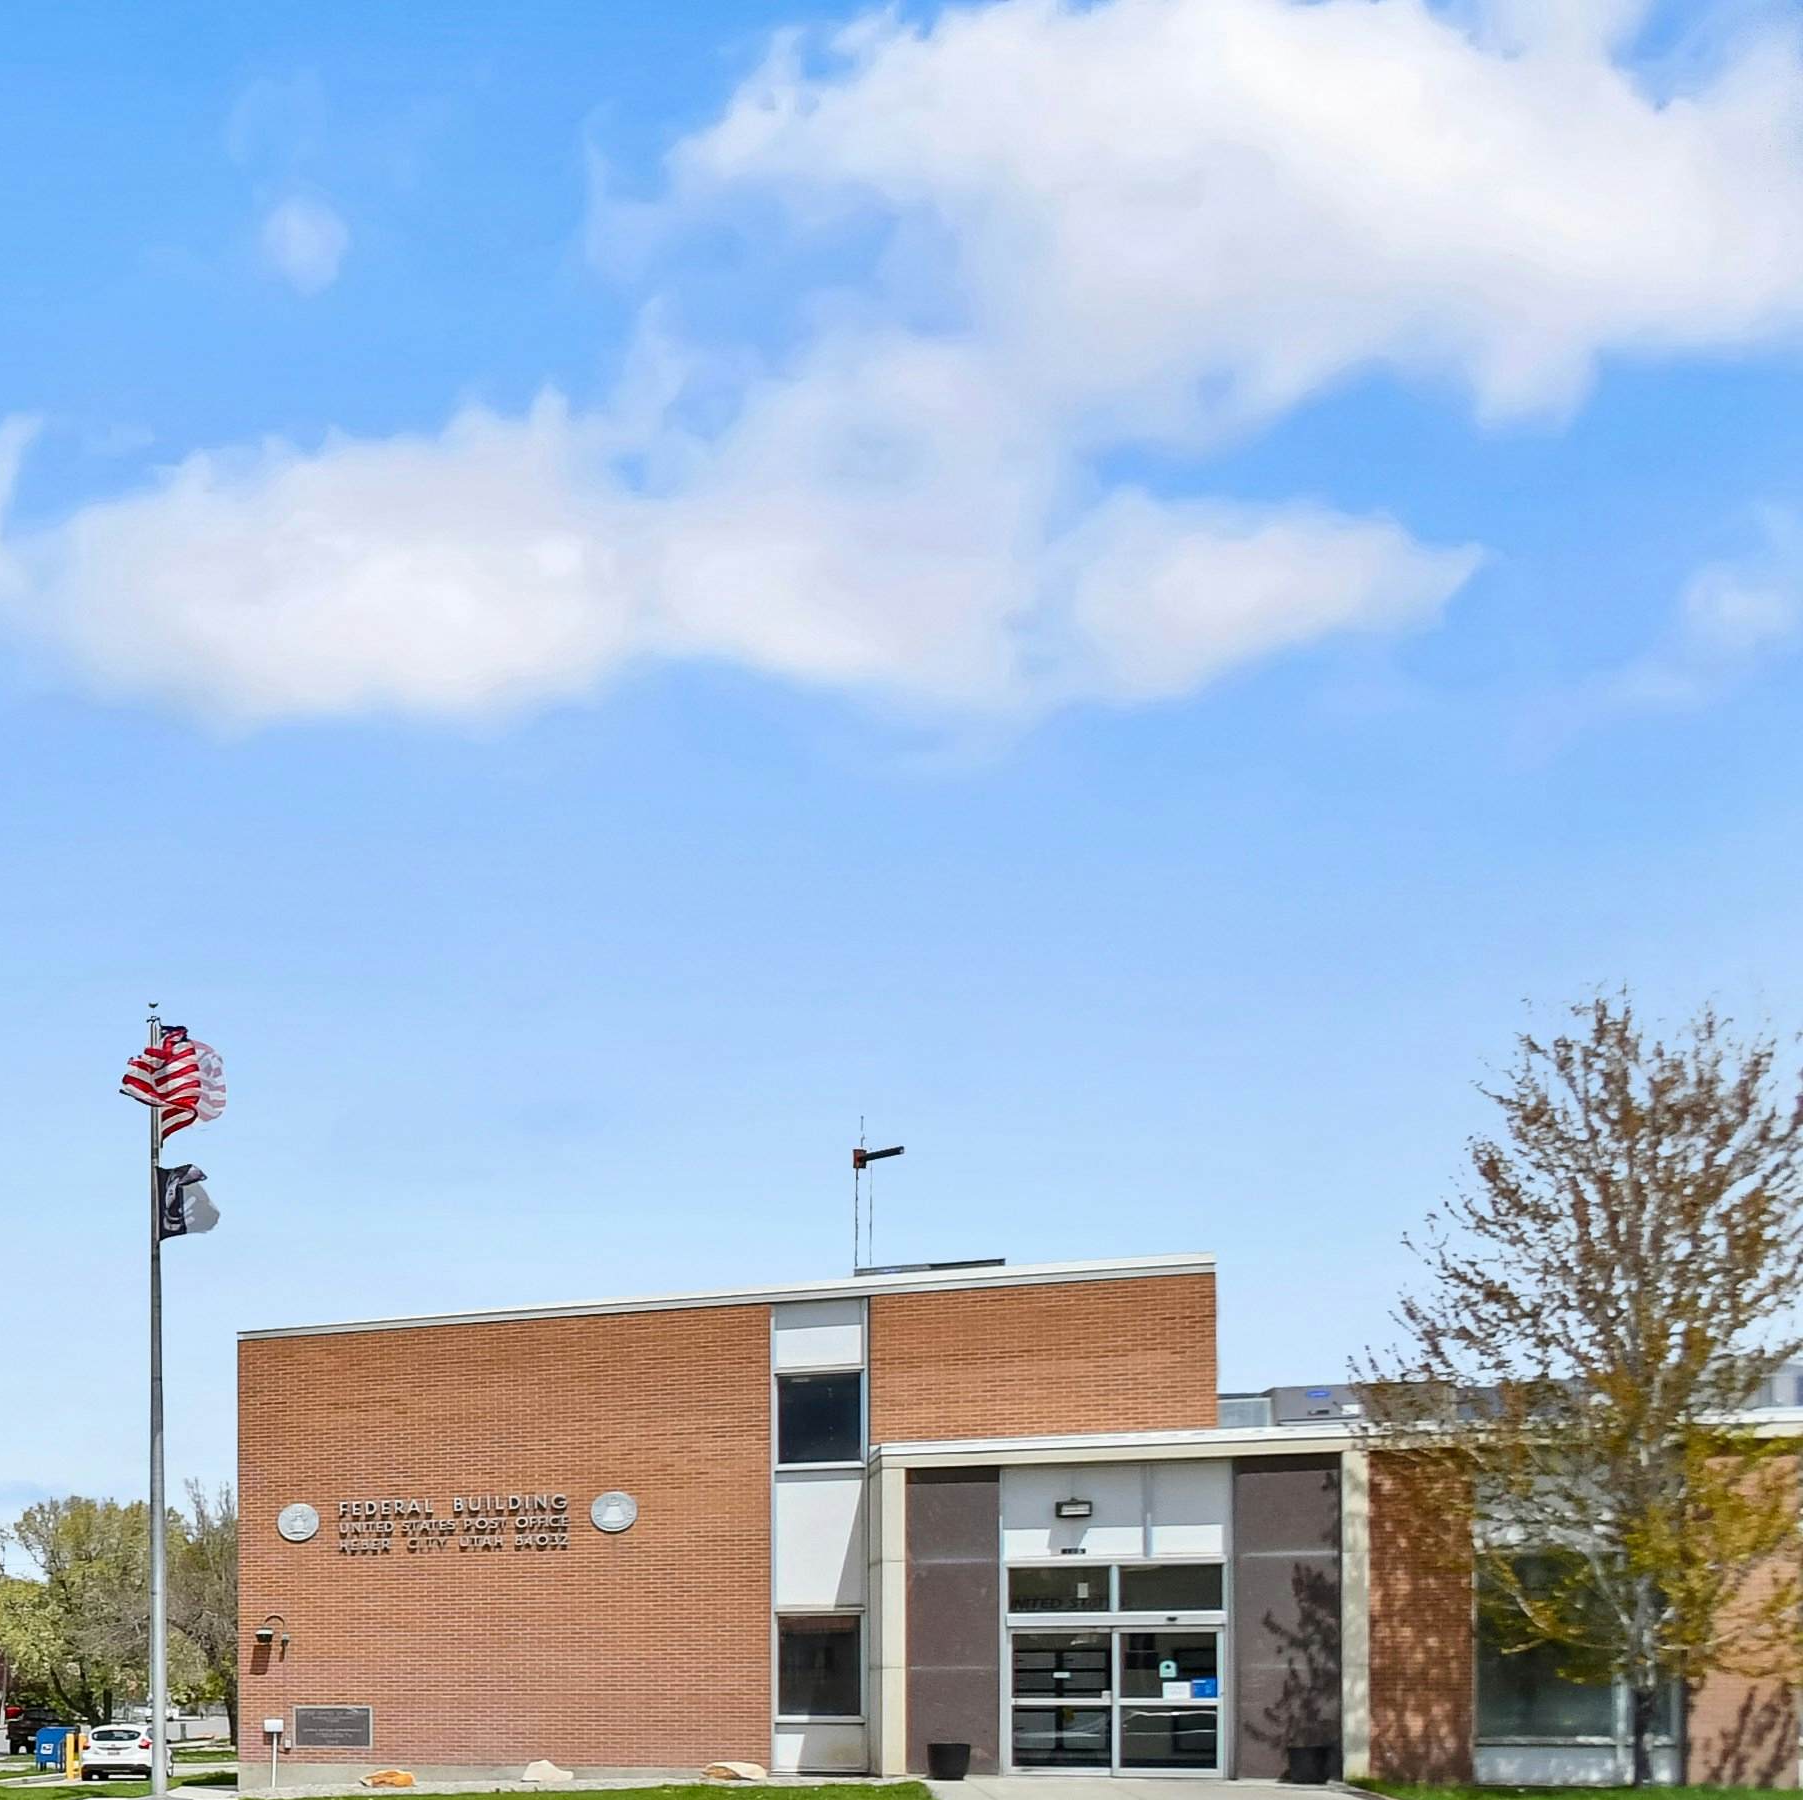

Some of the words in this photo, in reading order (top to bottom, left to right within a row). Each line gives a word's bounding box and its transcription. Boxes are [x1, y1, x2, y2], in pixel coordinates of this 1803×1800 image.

[339, 1499, 434, 1517] FEDERAL
[453, 1494, 568, 1512] BUILDING
[338, 1520, 395, 1533] UNITED
[401, 1519, 456, 1531] STATES
[463, 1517, 506, 1530] POST
[515, 1516, 569, 1529] OFFICE
[339, 1538, 391, 1551] HEBER
[407, 1537, 447, 1549] CITY
[459, 1535, 503, 1547] UTAH
[514, 1533, 569, 1546] 84032
